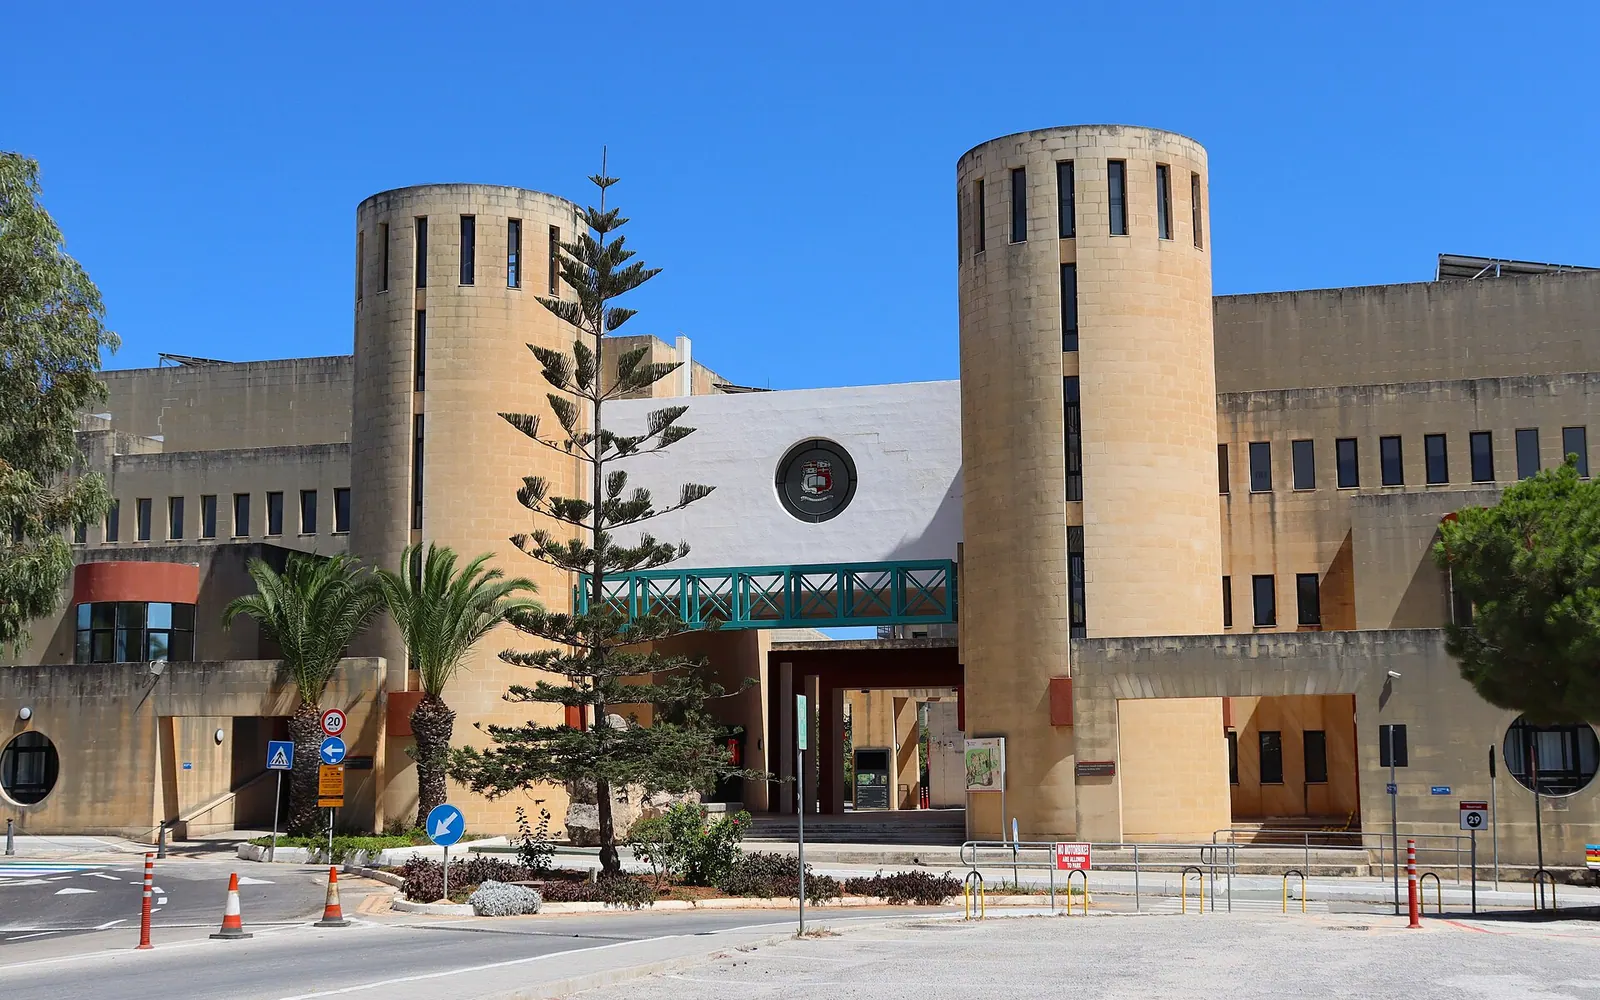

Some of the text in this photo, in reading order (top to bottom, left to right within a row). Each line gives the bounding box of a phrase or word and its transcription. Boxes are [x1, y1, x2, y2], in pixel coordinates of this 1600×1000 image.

[327, 717, 340, 727] 20
[1468, 815, 1480, 824] 29
[1057, 844, 1089, 855] NO MOTORBIKES
